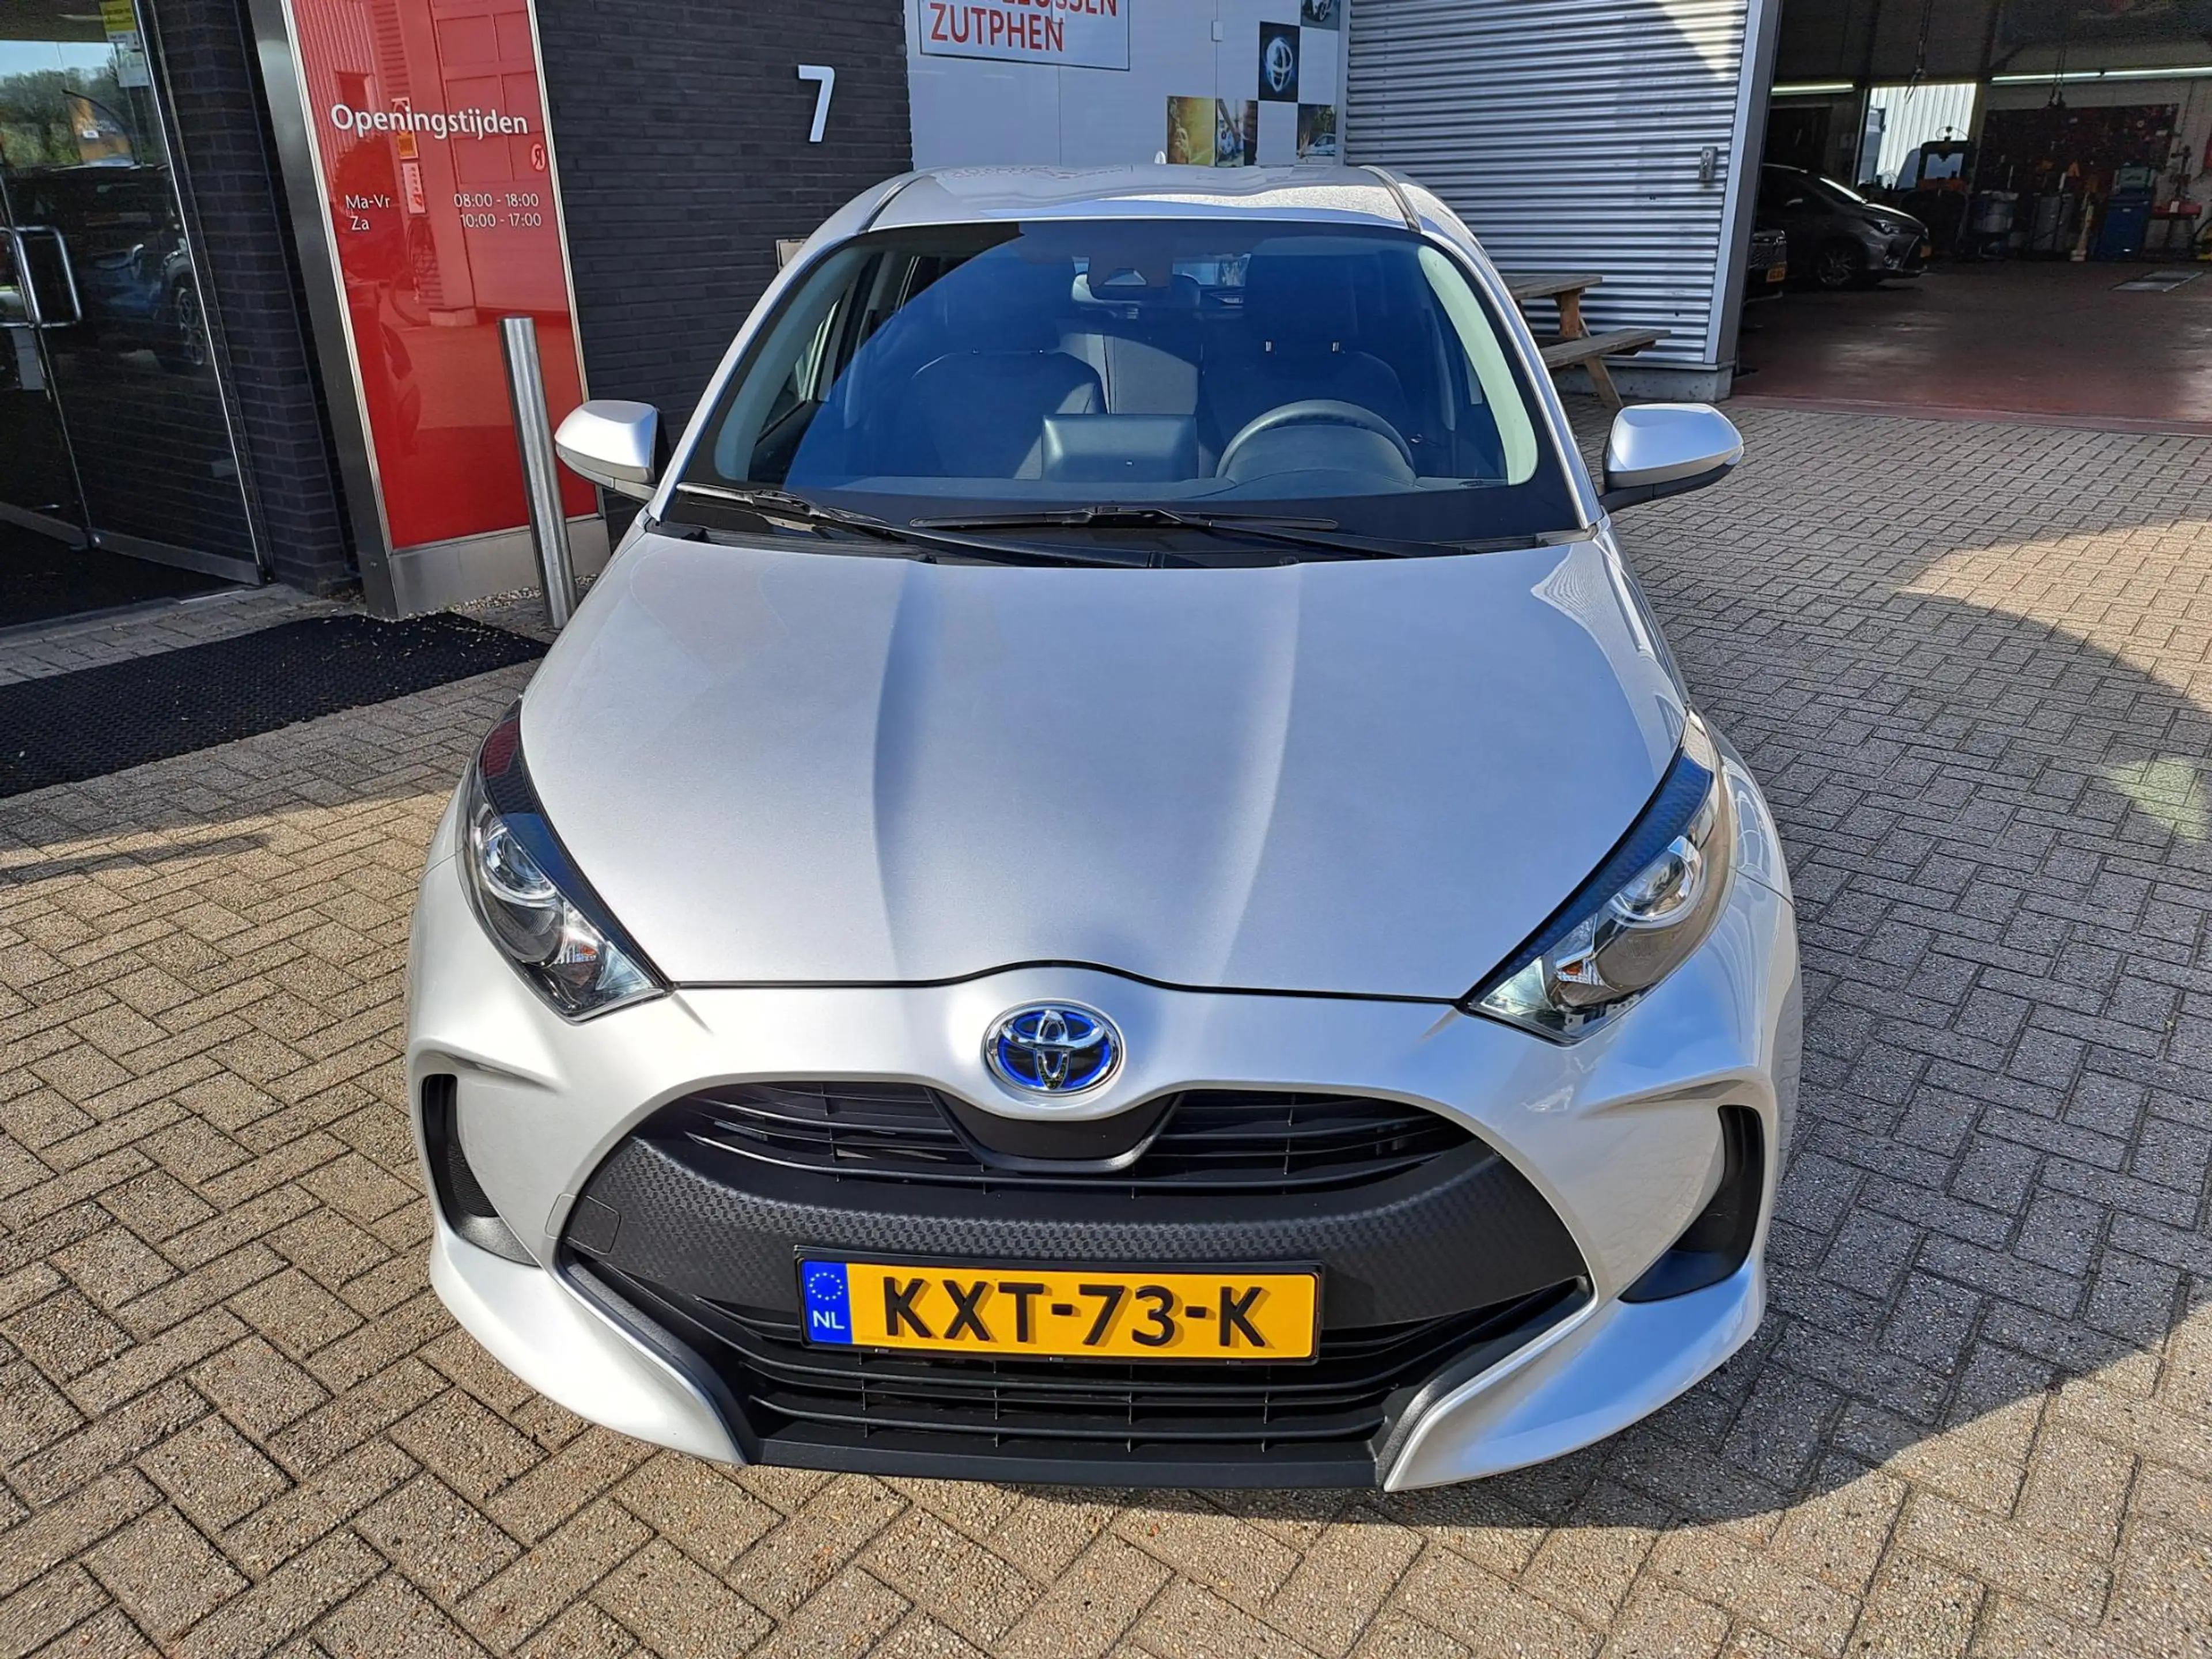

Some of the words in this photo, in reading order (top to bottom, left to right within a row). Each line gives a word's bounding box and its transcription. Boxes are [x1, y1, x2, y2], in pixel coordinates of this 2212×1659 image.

[929, 3, 1064, 52] ZUTPHEN
[798, 65, 835, 142] 7
[331, 104, 528, 140] Openingstijden
[345, 194, 390, 209] Ma-Vr
[454, 193, 493, 207] 08:00
[505, 193, 539, 207] 18:00
[349, 215, 370, 230] Za
[461, 213, 496, 228] 10:00
[508, 213, 542, 227] 17:00
[813, 1309, 845, 1330] NL
[882, 1276, 1266, 1348] KXT-73-K
